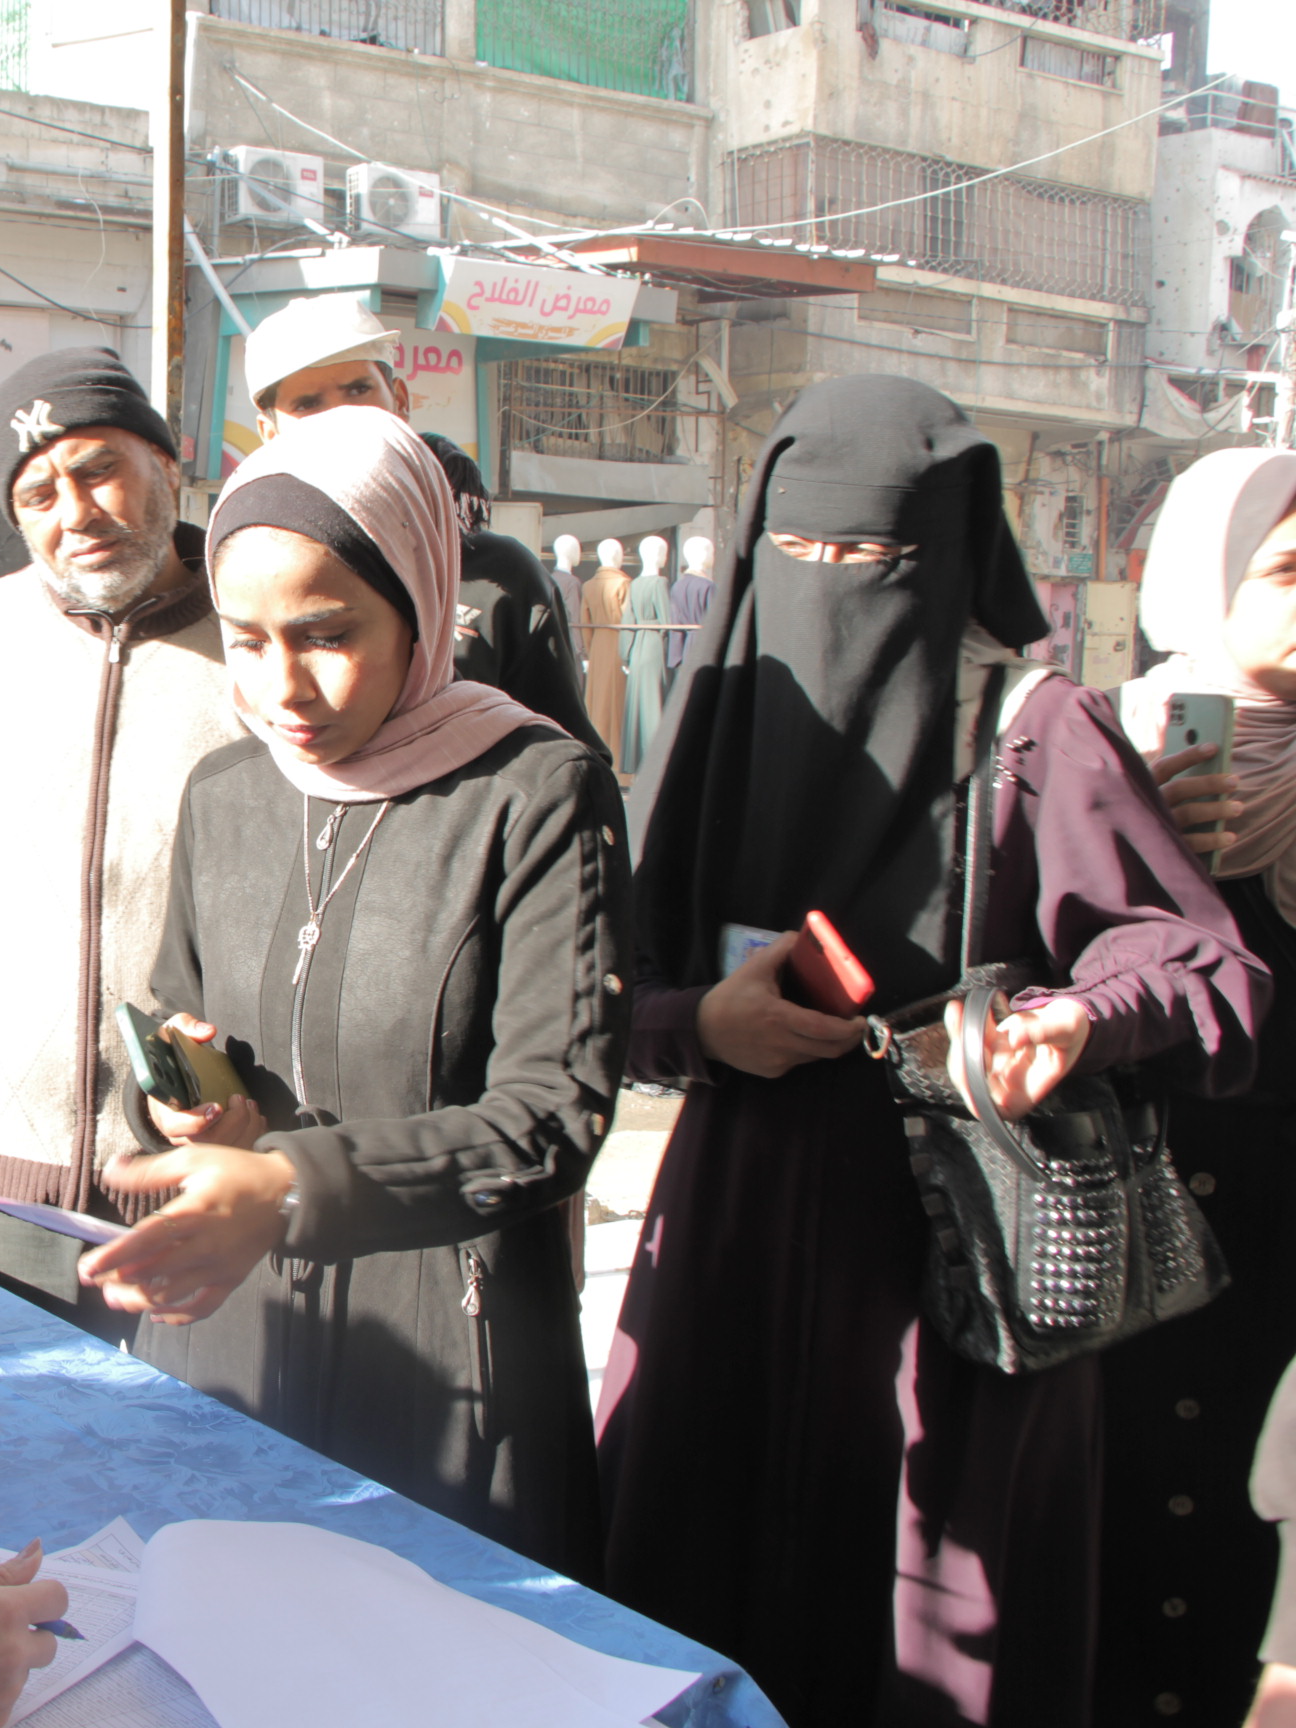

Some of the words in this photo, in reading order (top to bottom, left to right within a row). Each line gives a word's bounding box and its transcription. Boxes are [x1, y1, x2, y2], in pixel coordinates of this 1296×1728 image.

[466, 275, 540, 311] الفلاح
[539, 284, 612, 320] معرض
[10, 399, 66, 452] NY
